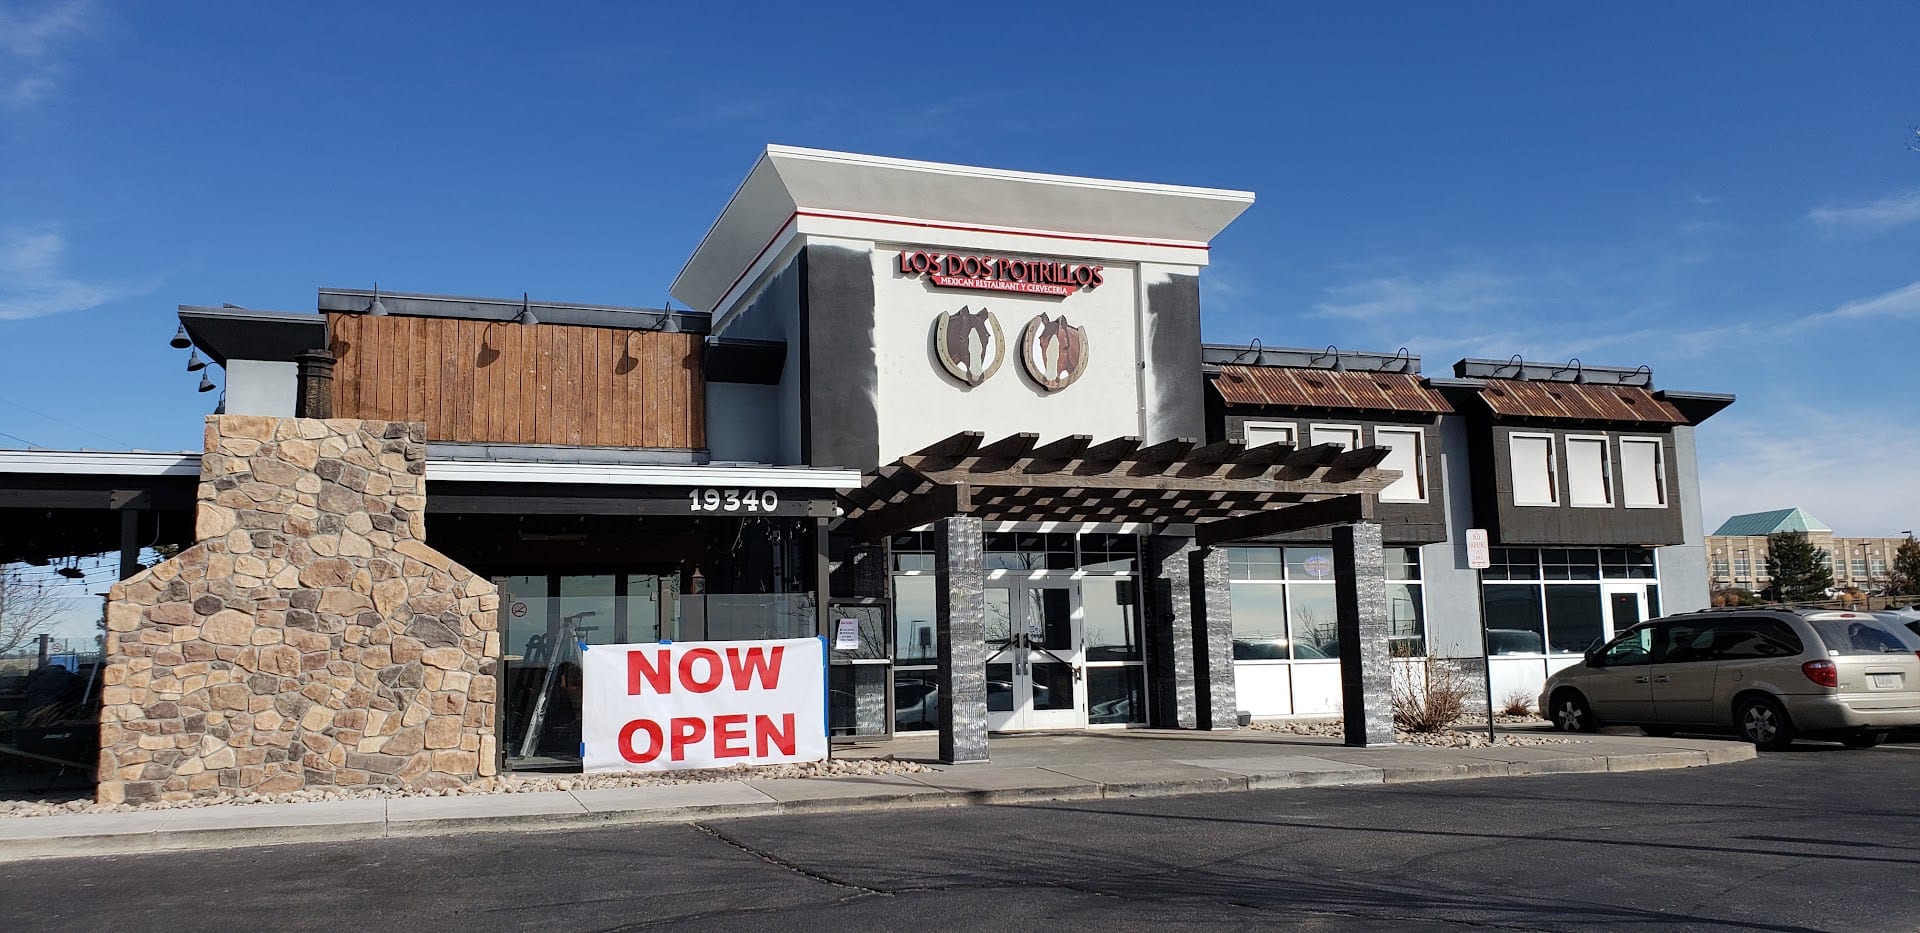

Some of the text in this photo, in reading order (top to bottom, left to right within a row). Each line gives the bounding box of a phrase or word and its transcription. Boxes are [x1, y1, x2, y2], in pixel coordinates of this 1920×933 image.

[900, 250, 1104, 287] LOS DOS POTRILLOS
[940, 276, 1068, 295] MEXICAN RESTAURANT Y CERVECERIA
[689, 488, 778, 512] 19340
[626, 645, 785, 696] NOW
[617, 712, 796, 764] OPEN
